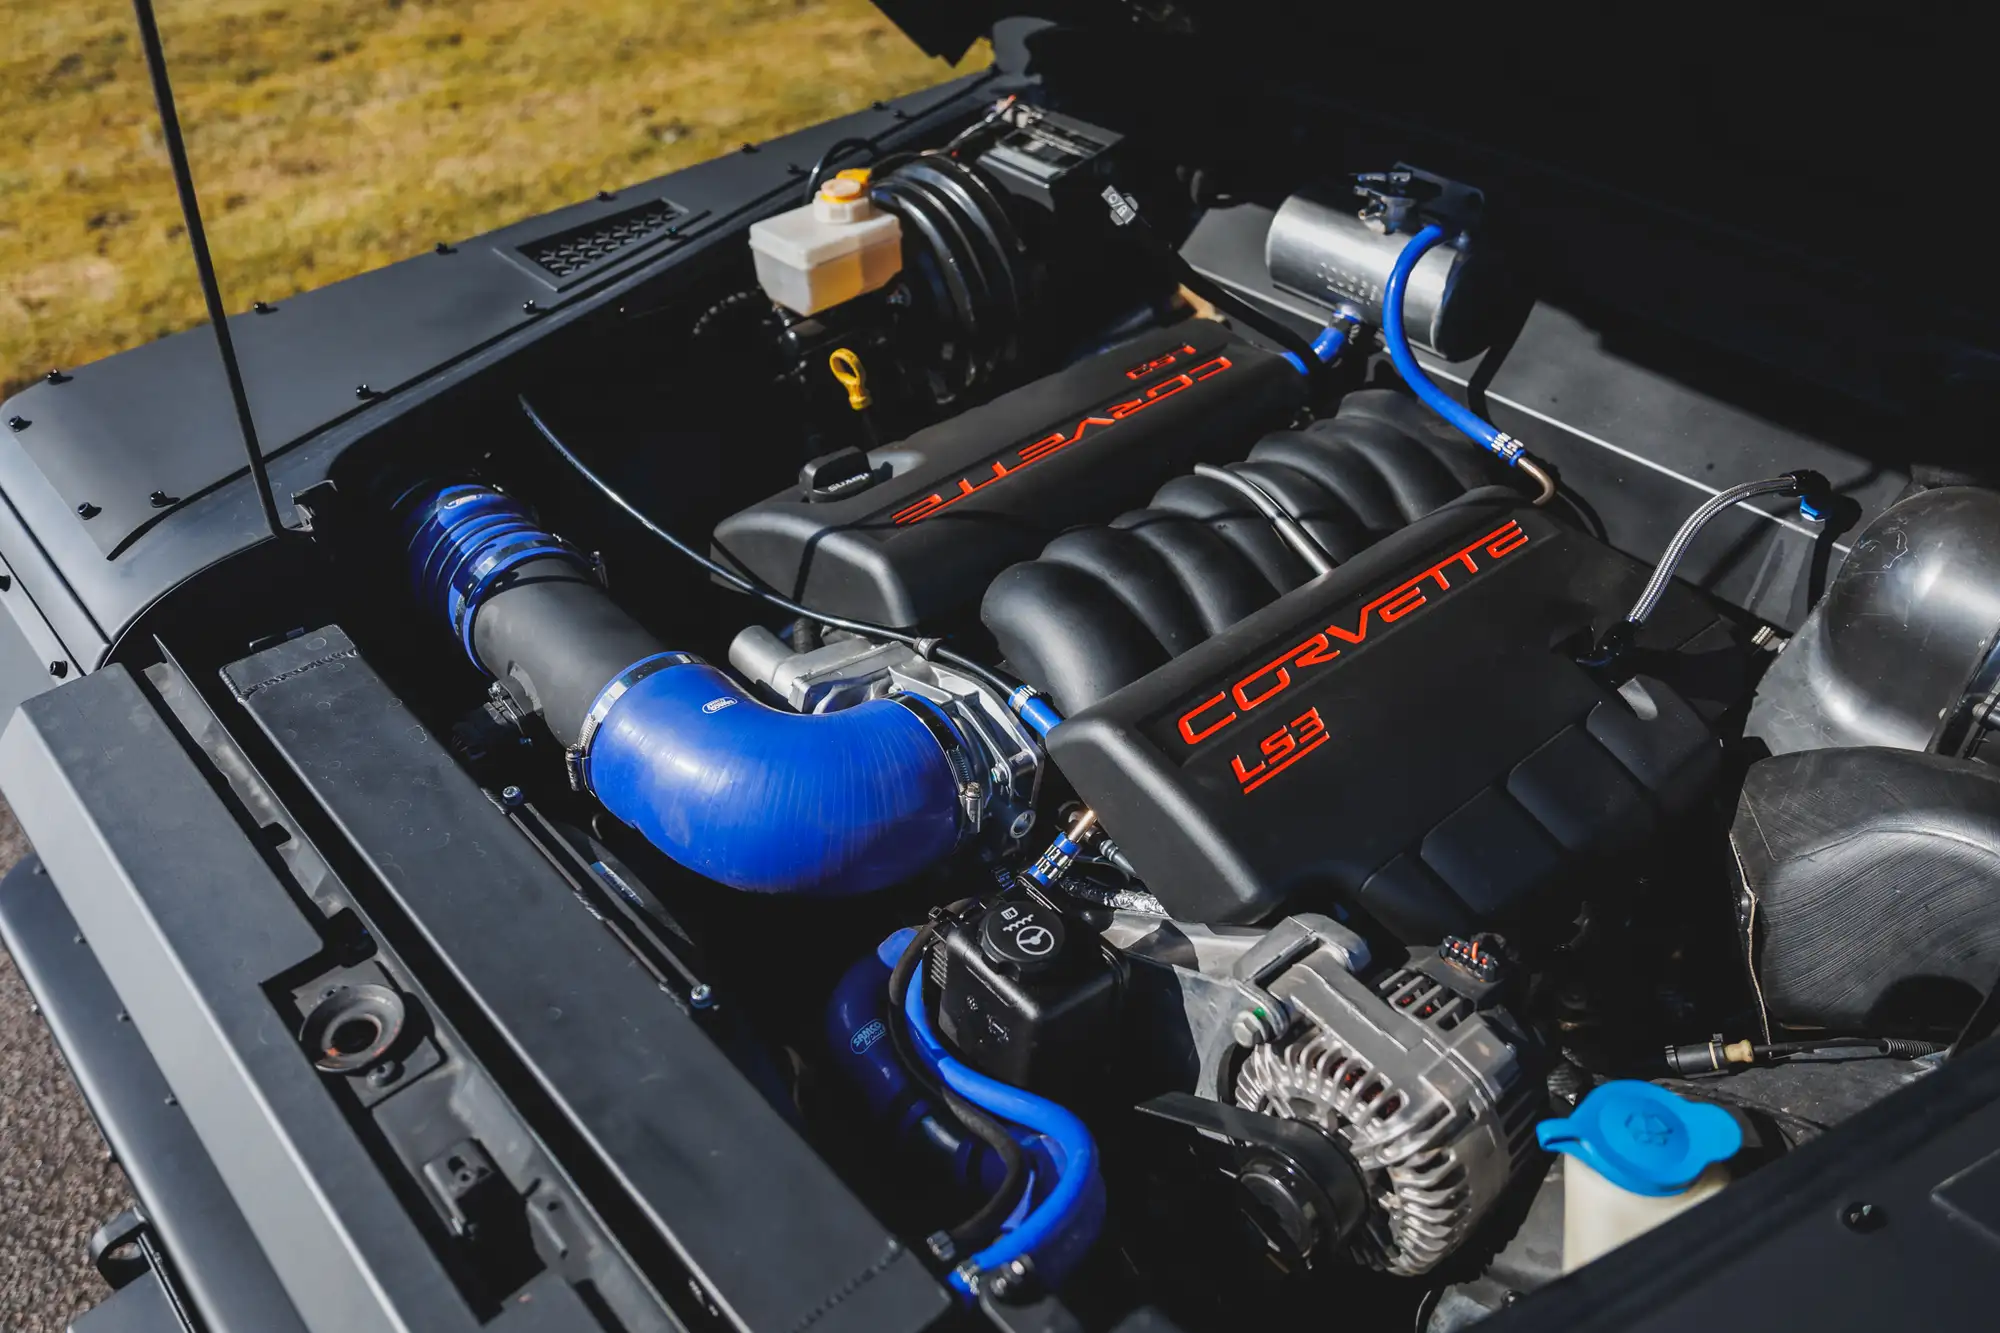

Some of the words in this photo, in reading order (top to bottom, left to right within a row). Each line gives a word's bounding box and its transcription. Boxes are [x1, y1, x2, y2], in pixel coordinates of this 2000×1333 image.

[1125, 344, 1197, 380] LS3
[892, 356, 1233, 525] CORVETTE
[1177, 519, 1530, 746] CORVETTE
[1229, 705, 1328, 785] LS3
[853, 1021, 882, 1048] SAMCO
